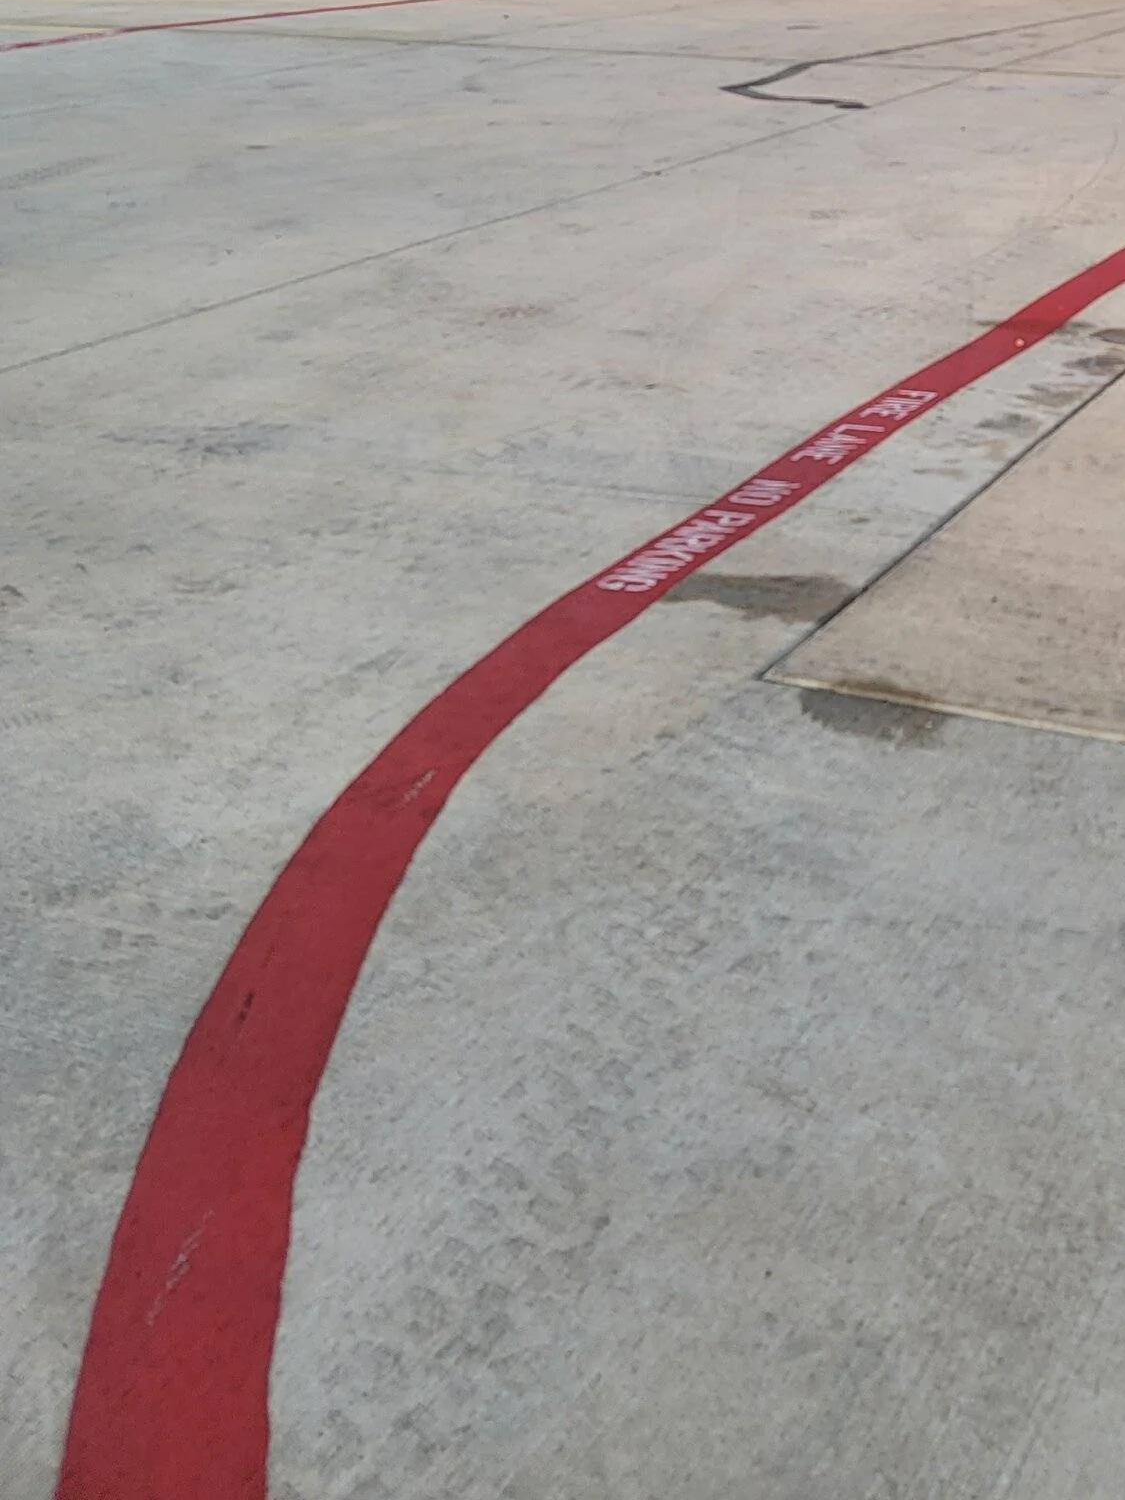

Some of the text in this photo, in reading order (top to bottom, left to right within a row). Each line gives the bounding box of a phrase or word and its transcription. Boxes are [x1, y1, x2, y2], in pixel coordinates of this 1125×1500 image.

[595, 389, 938, 593] FIRE LANE NO PARKING
